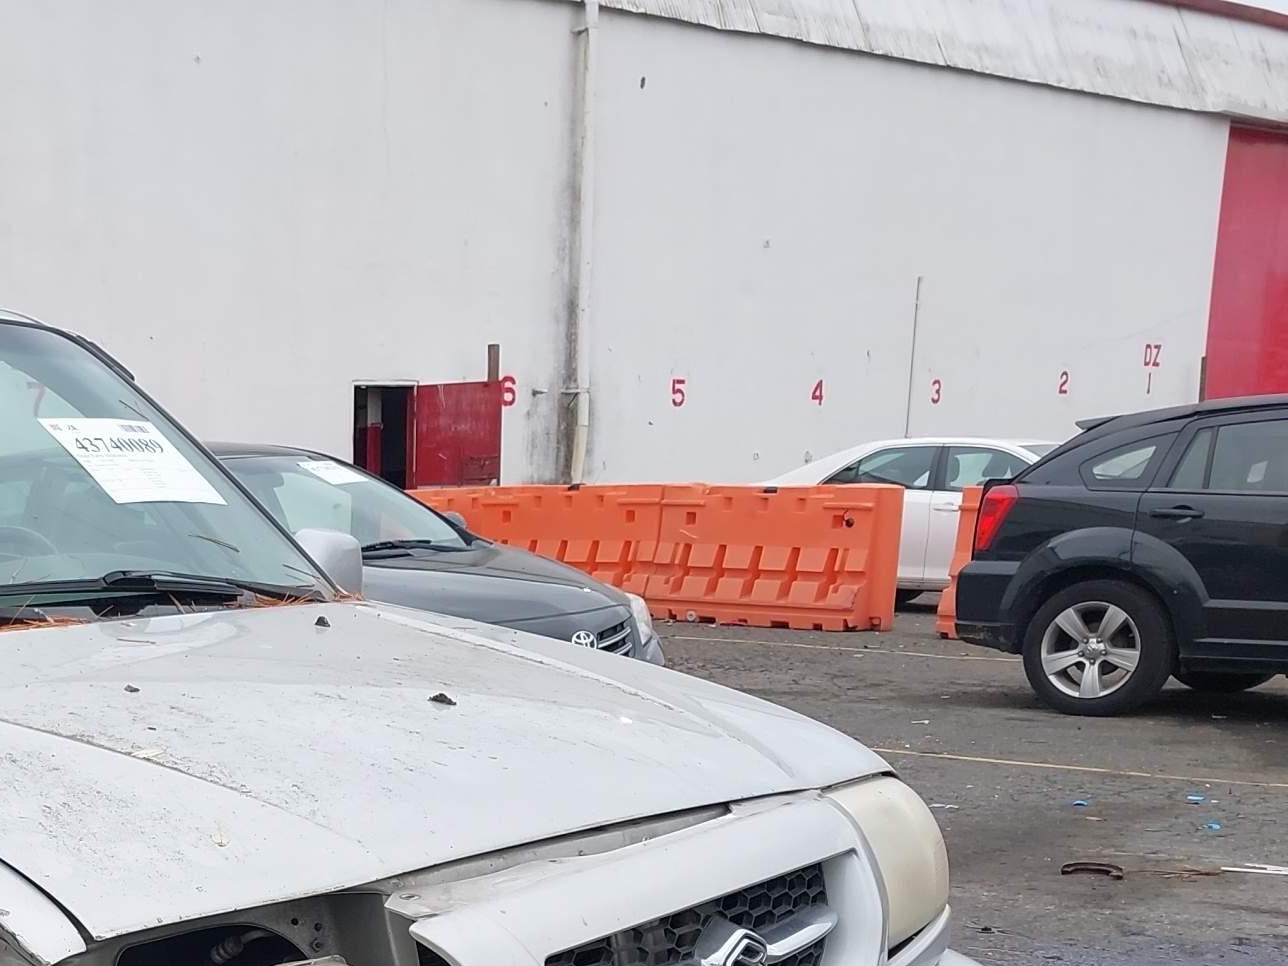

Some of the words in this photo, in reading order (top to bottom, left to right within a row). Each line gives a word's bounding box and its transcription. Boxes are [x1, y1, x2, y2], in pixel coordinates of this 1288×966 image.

[1143, 344, 1162, 367] DZ
[501, 375, 517, 407] 6
[671, 378, 686, 407] 5
[811, 379, 824, 406] 4
[931, 379, 942, 404] 3
[1058, 371, 1069, 394] 2
[75, 437, 164, 453] 43740089
